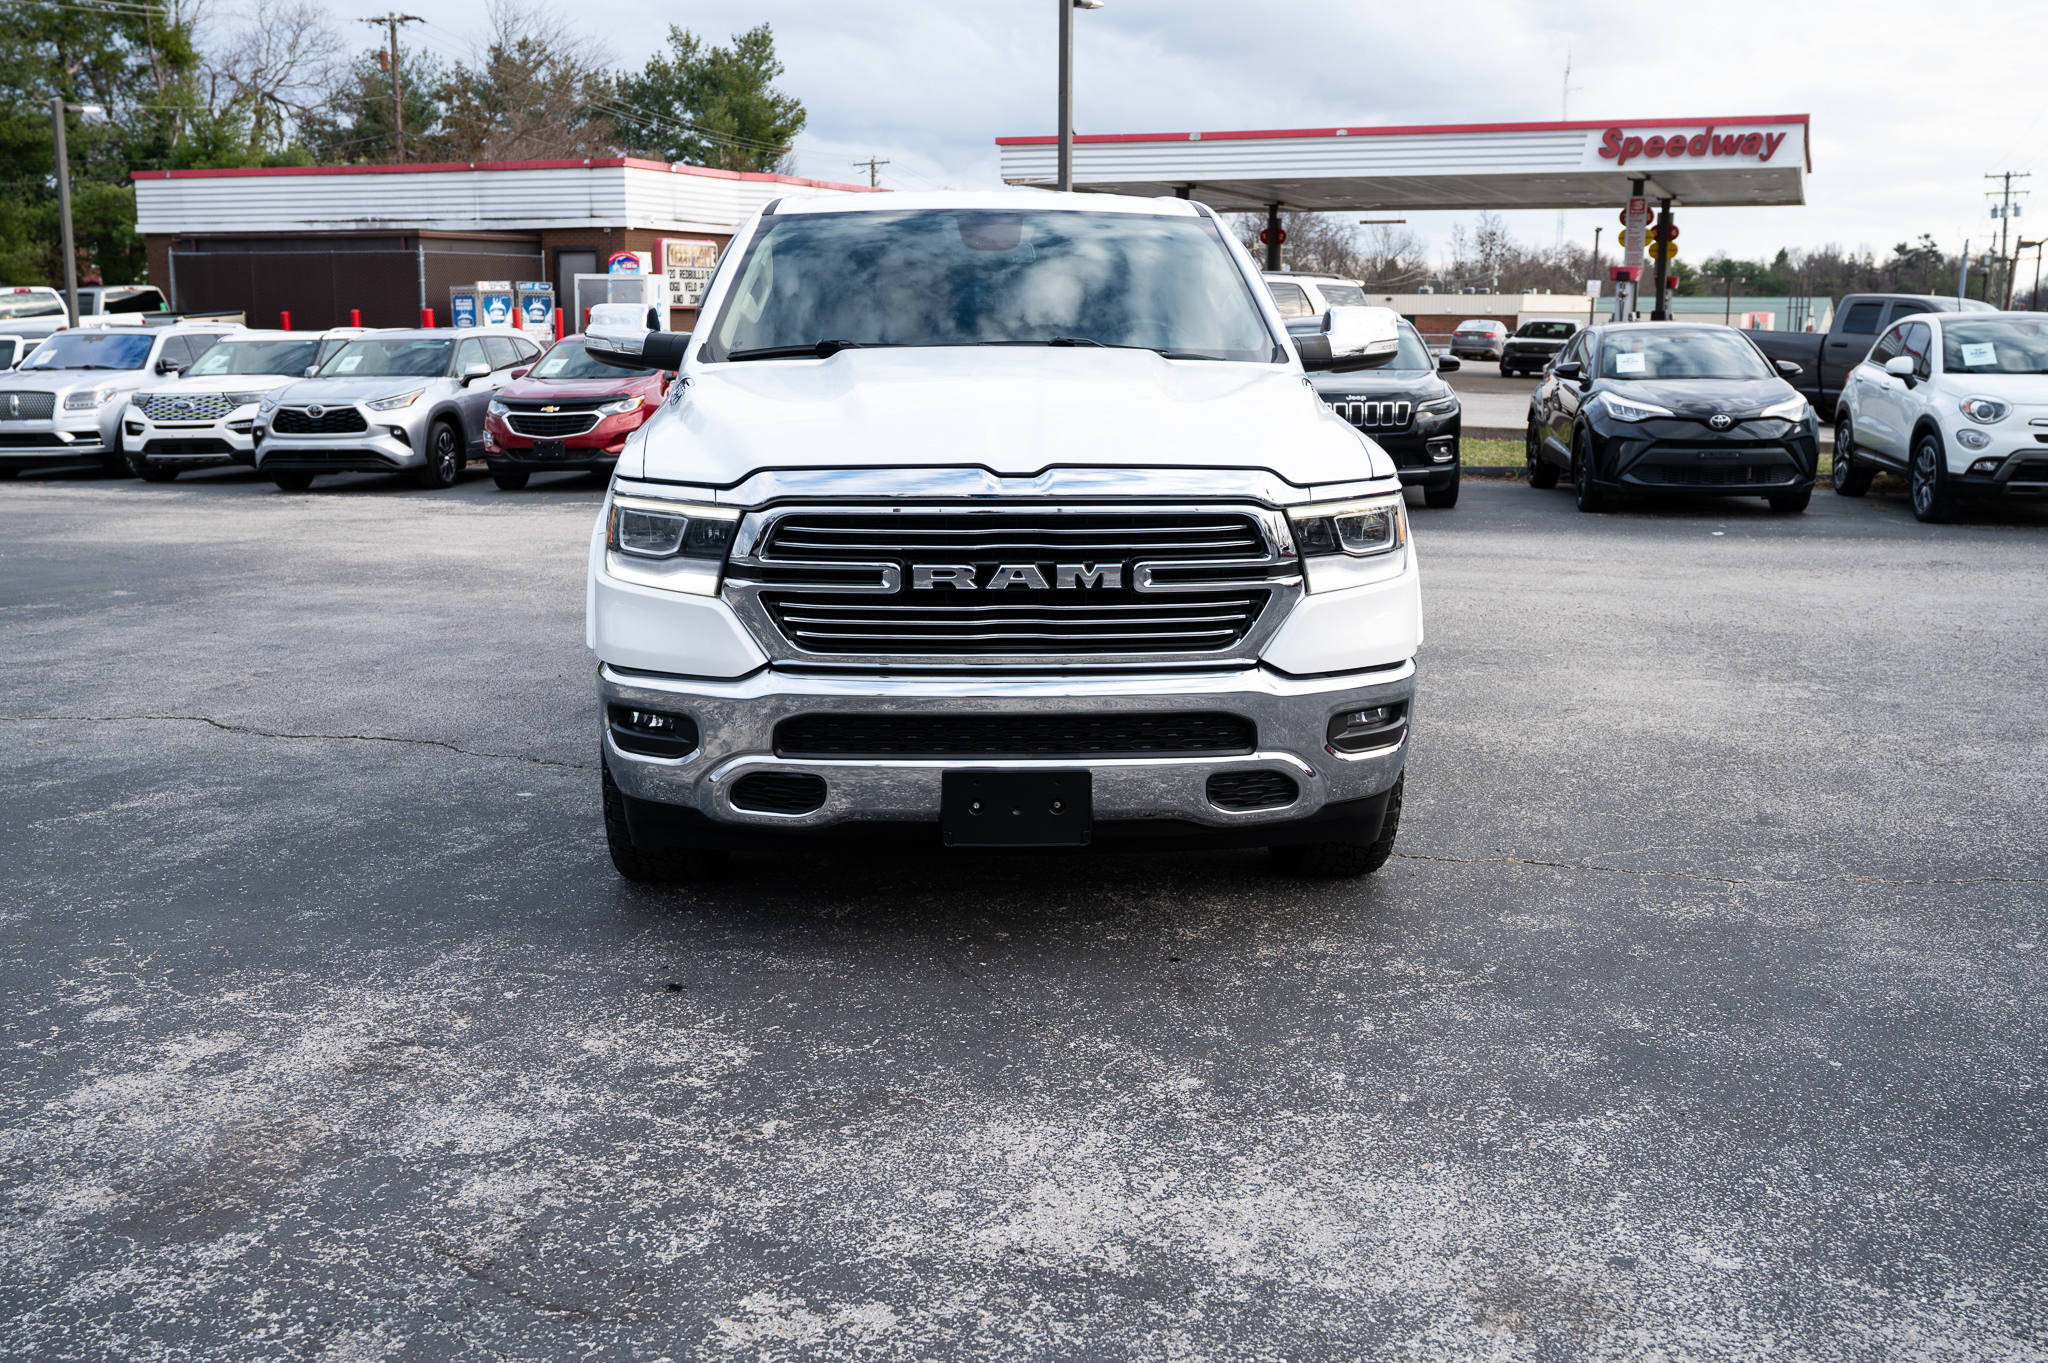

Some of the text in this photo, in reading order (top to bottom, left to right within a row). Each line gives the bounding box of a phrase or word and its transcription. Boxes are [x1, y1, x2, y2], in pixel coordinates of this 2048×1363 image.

[1598, 126, 1787, 166] Speedway
[673, 294, 684, 304] AND
[1345, 394, 1367, 402] Jeep
[912, 563, 1123, 590] RAM
